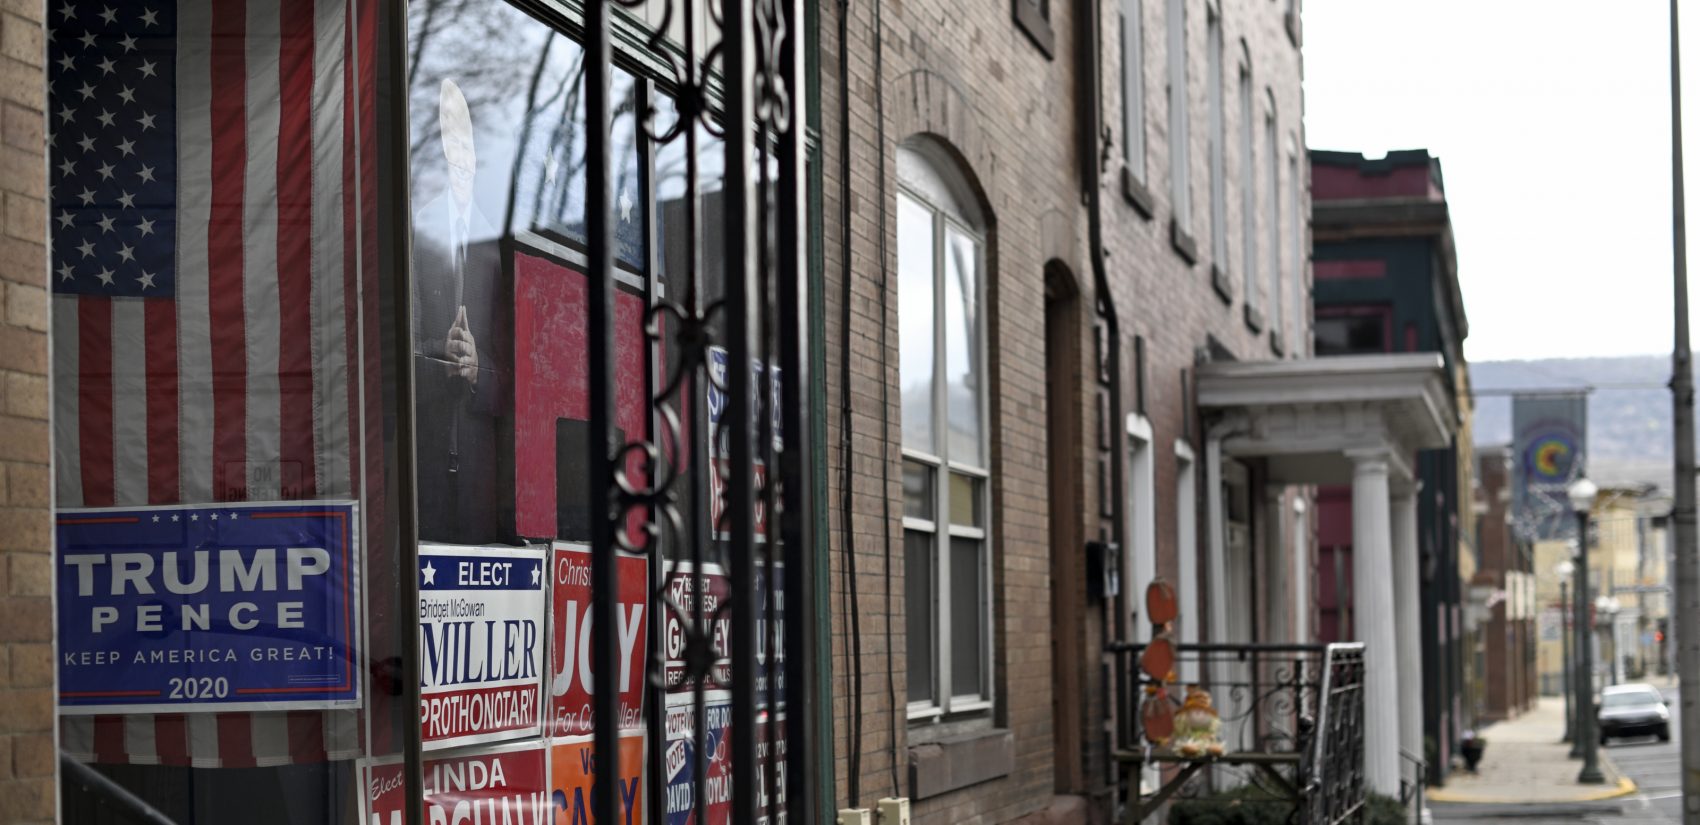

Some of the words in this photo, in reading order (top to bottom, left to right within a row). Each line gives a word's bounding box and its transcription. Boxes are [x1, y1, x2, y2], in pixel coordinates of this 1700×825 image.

[63, 547, 331, 597] TRUMP
[458, 561, 513, 587] ELECT
[420, 598, 450, 625] Bridget
[450, 599, 485, 618] McGowan
[684, 594, 718, 612] THESA
[91, 601, 305, 633] PENCE
[65, 651, 120, 666] KEEP
[133, 649, 238, 664] AMERICA
[250, 646, 334, 662] GREAT!
[420, 618, 537, 688] MILLER
[168, 677, 229, 700] 2020
[421, 688, 535, 737] PROTHONOTARY
[554, 706, 577, 733] For
[370, 770, 403, 800] Elect
